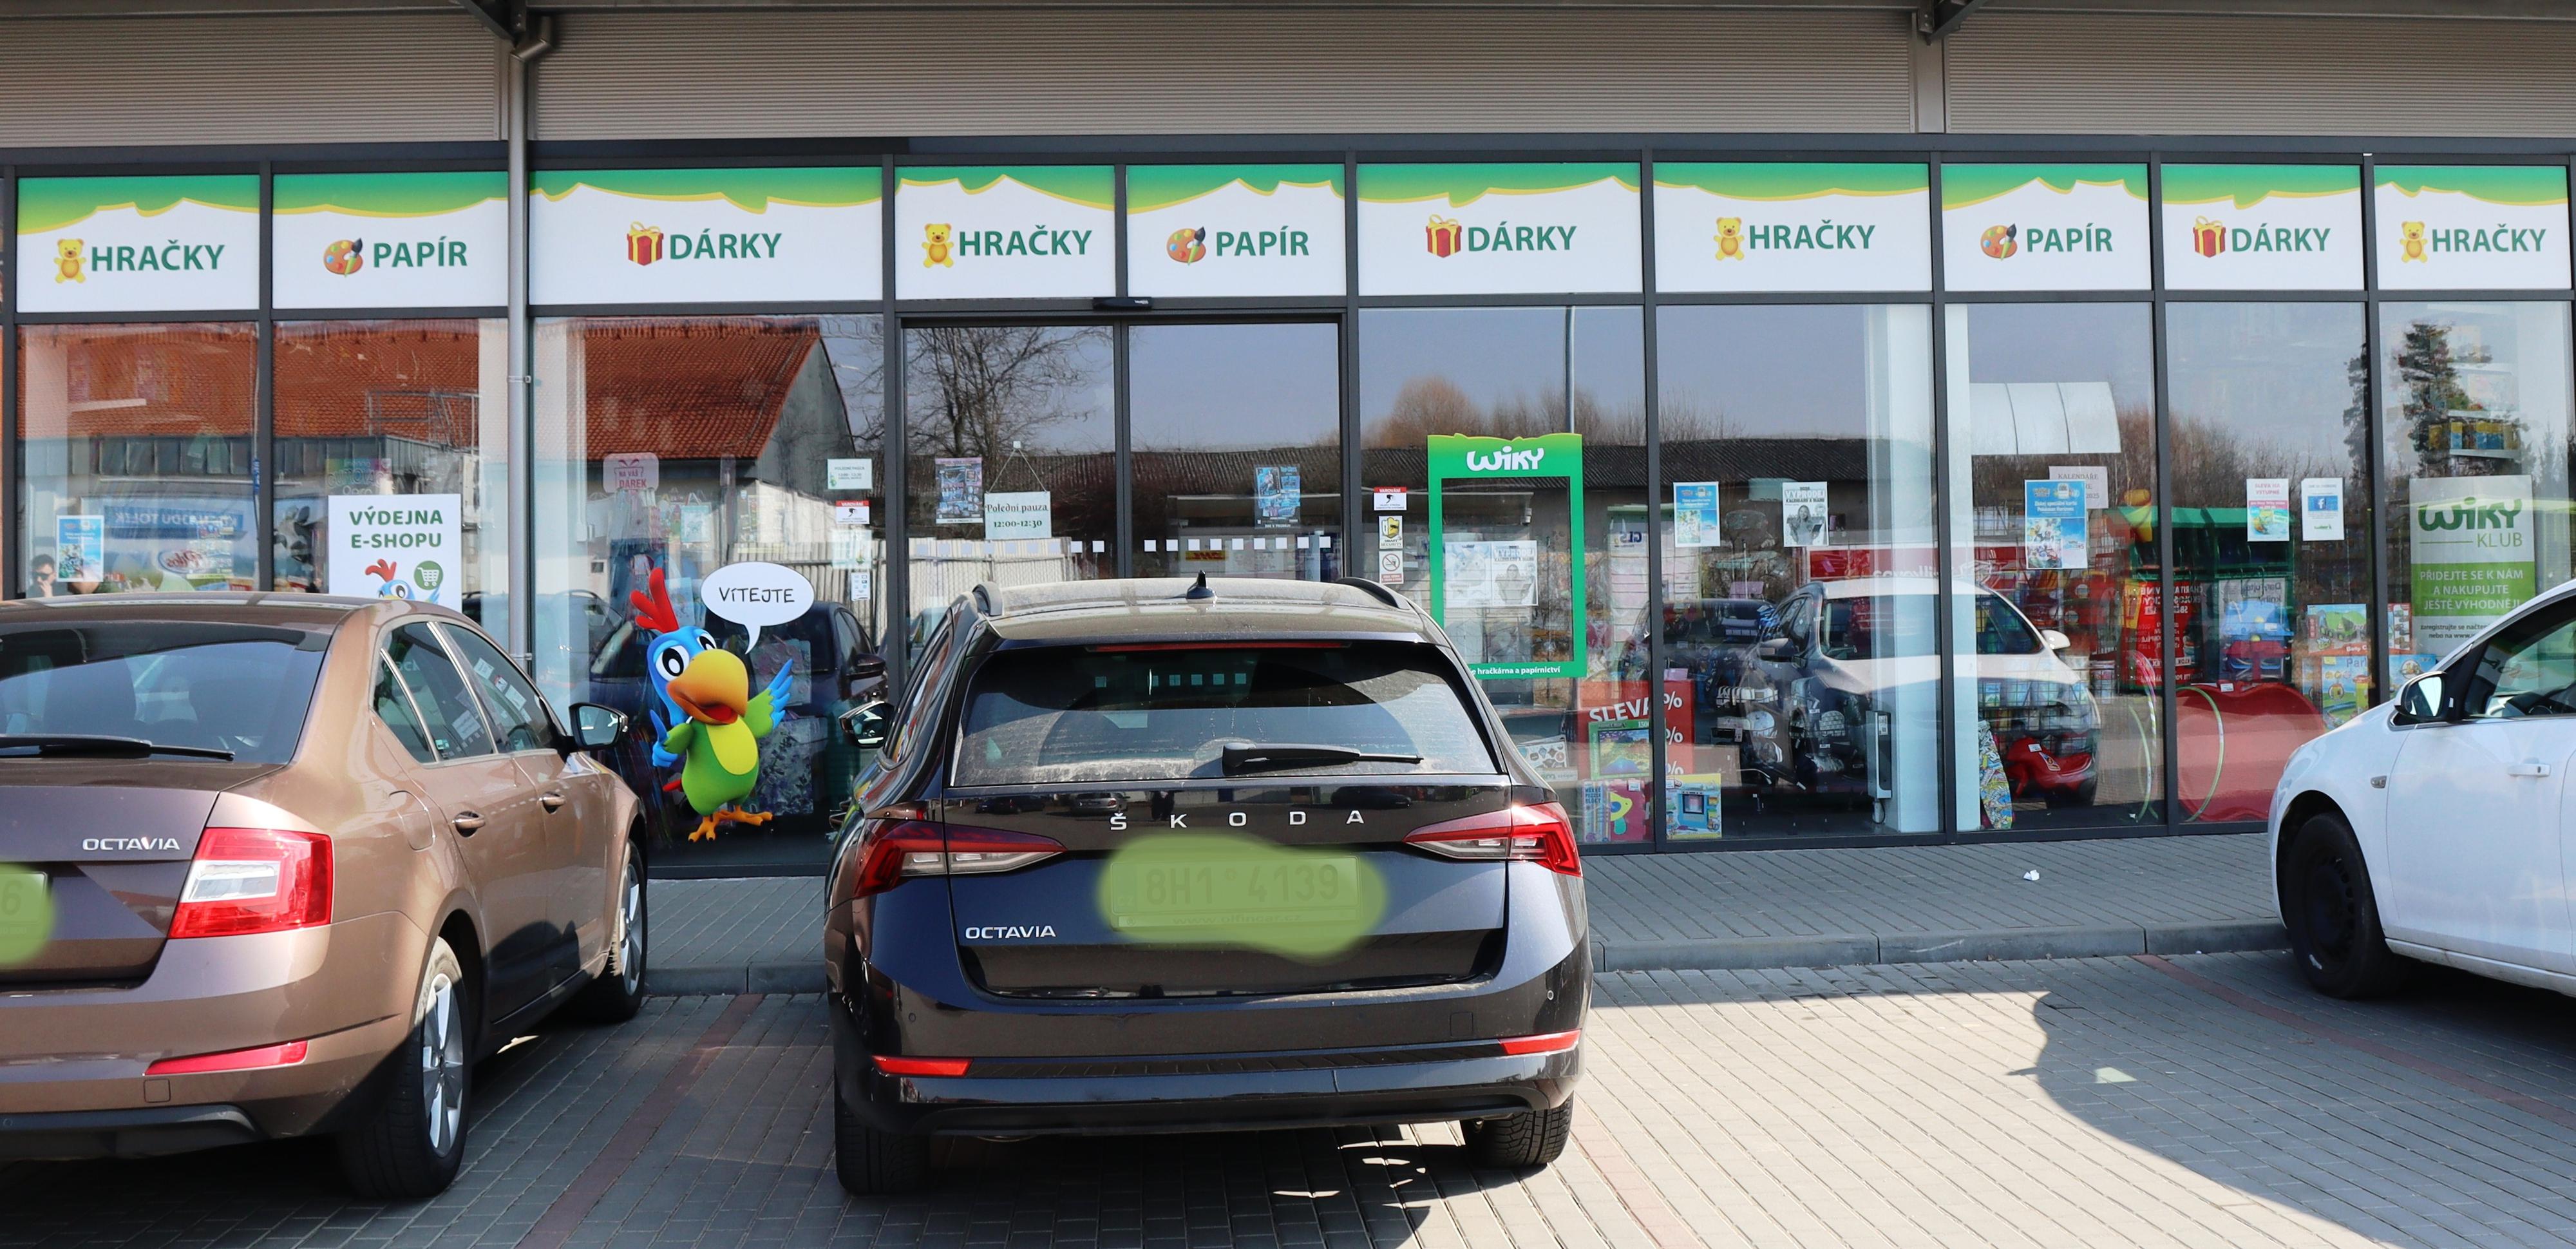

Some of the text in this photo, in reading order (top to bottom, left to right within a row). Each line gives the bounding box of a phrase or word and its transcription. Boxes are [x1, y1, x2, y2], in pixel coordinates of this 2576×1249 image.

[670, 228, 782, 260] DÁRKY
[959, 224, 1092, 256] HRAČKY
[1216, 225, 1309, 257] PAPÍR
[1468, 221, 1577, 252] DÁRKY
[1749, 220, 1876, 250] HRAČKY
[2027, 222, 2113, 253] PAPÍR
[2231, 223, 2331, 253] DÁRKY
[2432, 224, 2546, 253] HRAČKY
[91, 240, 225, 272] HRAČKY
[374, 236, 468, 268] PAPÍR
[348, 505, 444, 526] VÝDEJNA
[1021, 504, 1048, 513] pauza
[994, 520, 1042, 528] 12:00-12:30
[350, 533, 442, 549] E-SHOPU
[2477, 533, 2523, 548] KLUB
[2420, 567, 2523, 580] PŘIDEJTE SE K NÁM
[719, 587, 795, 604] VÍTEJTE
[2433, 584, 2509, 595] A NAKUPUJTE
[2424, 599, 2453, 610] JEŠTĚ
[1477, 666, 1514, 675] hračkárna
[1520, 665, 1561, 675] papírnictví
[82, 837, 180, 850] OCTAVIA
[965, 925, 1057, 939] OCTAVIA
